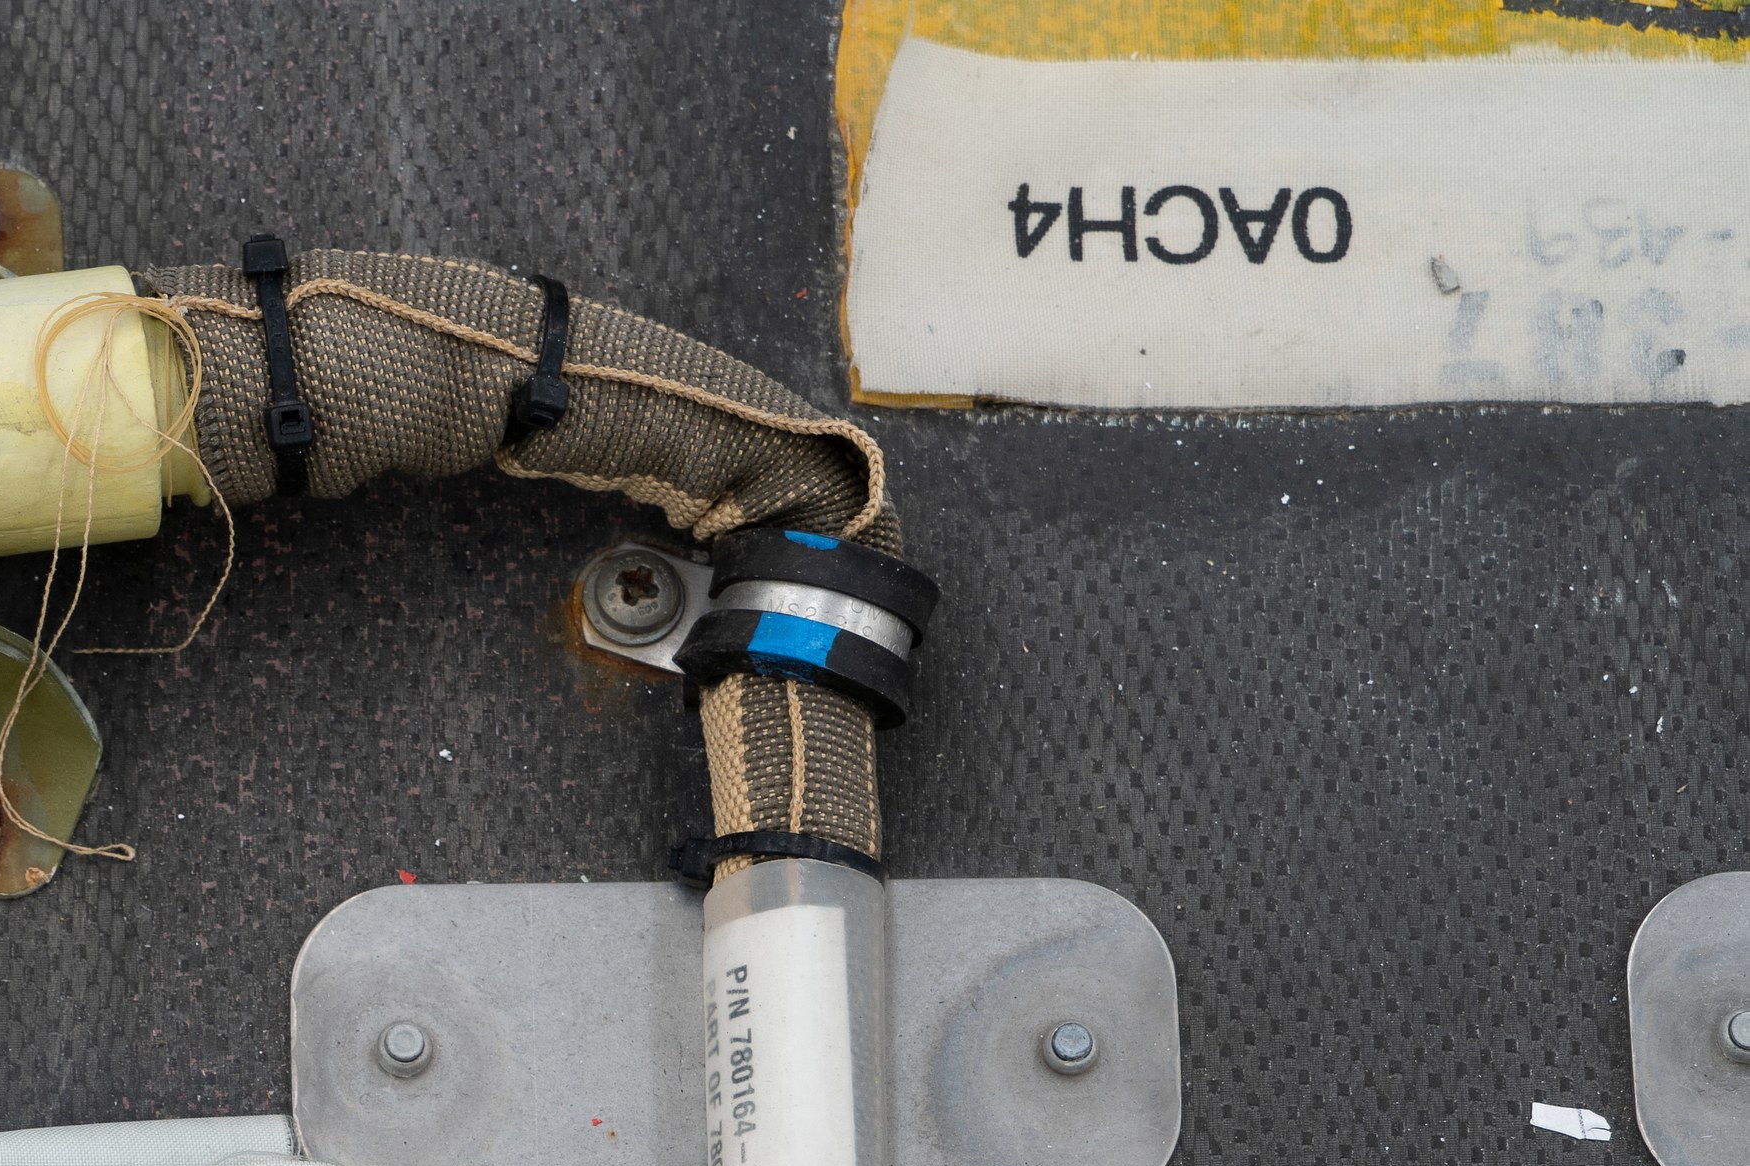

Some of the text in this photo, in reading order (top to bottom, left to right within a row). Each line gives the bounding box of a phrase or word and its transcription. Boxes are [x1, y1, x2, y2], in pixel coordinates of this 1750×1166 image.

[704, 979, 721, 1058] PART
[725, 964, 749, 1020] P/N
[706, 1072, 723, 1118] OF
